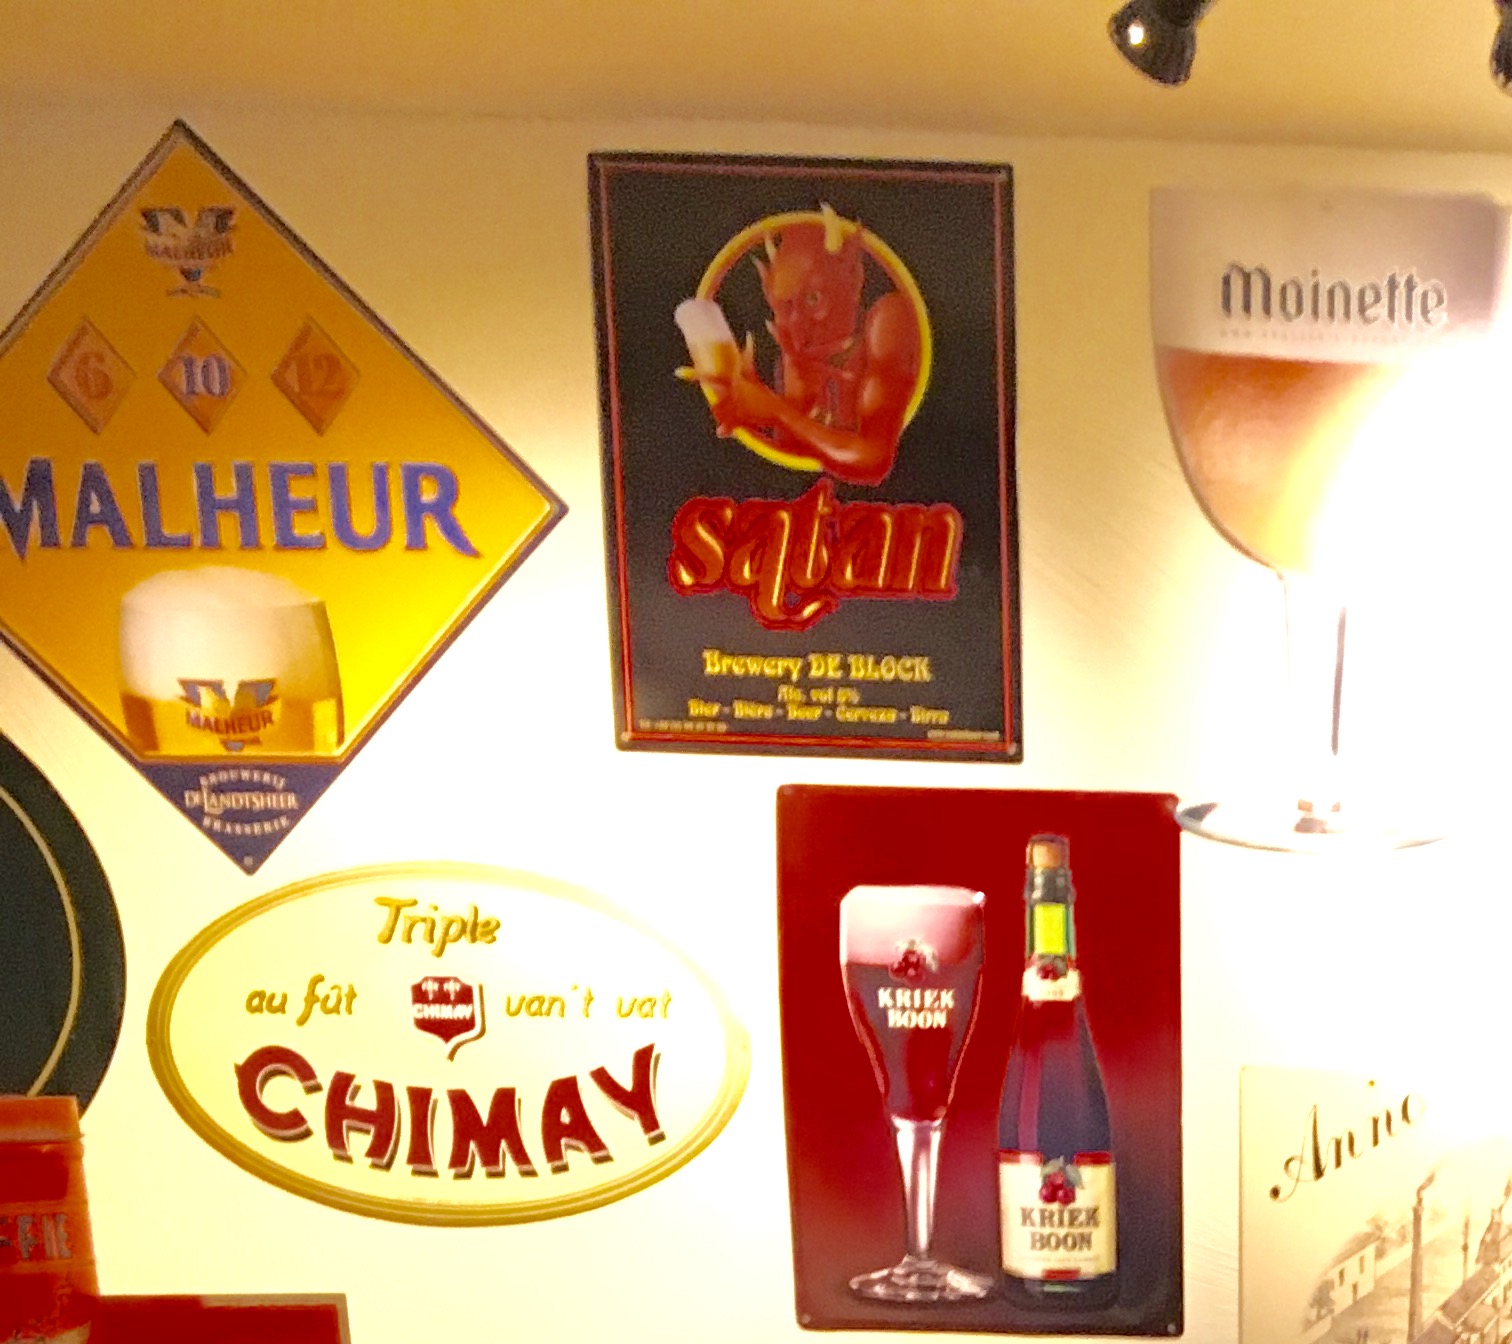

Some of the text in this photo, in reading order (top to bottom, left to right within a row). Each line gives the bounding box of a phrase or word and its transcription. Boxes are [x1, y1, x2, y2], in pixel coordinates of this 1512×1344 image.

[1220, 262, 1447, 326] Moinette
[75, 352, 113, 399] 6
[182, 353, 232, 398] 10
[297, 353, 345, 399] 12
[0, 456, 483, 562] MALHEUR
[703, 648, 934, 682] Brewery DE BLOCK
[186, 708, 274, 735] MALHEUR
[375, 896, 501, 957] Triple
[246, 974, 357, 1026] au fût
[412, 1003, 473, 1020] CHIMAY
[616, 989, 673, 1019] vat
[877, 986, 955, 1009] KRIEK
[888, 1009, 947, 1030] BOON
[234, 1043, 667, 1180] CHIMAY
[1020, 1206, 1100, 1229] KRIEK
[1030, 1230, 1093, 1252] BOON
